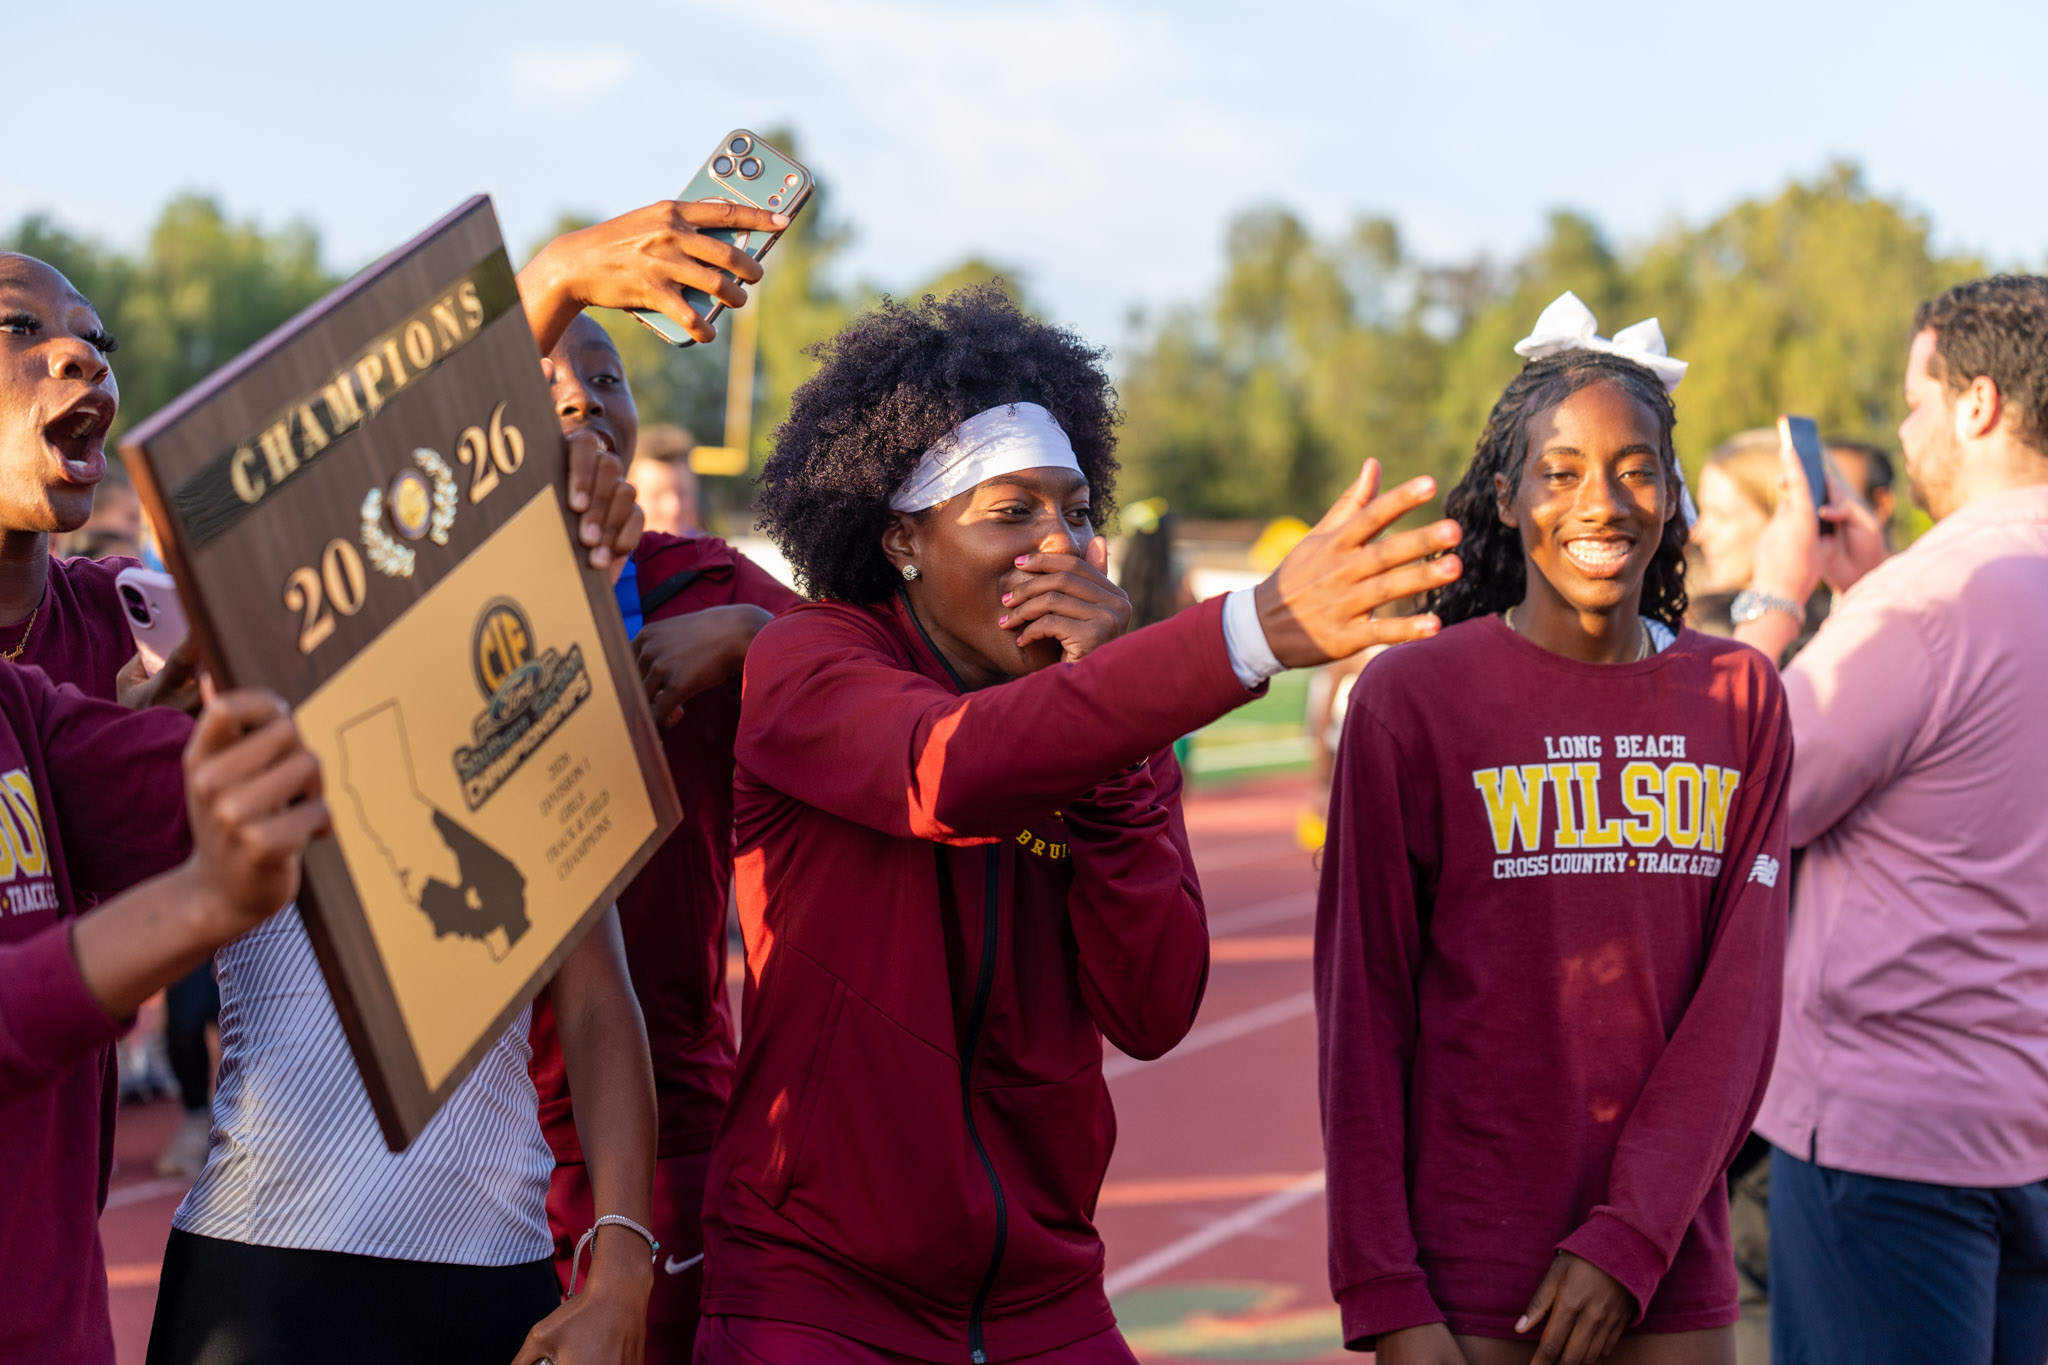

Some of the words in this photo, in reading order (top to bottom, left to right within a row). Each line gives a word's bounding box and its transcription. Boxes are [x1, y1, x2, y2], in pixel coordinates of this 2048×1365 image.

[231, 281, 484, 503] CHAMPIONS
[283, 537, 367, 654] 20
[456, 401, 526, 504] 26
[480, 611, 528, 692] CIF
[1545, 736, 1602, 759] LONG
[1614, 735, 1686, 758] BEACH
[1016, 829, 1070, 859] BRUI
[1472, 761, 1741, 854] WILSON
[1493, 855, 1549, 879] CROSS
[1550, 852, 1629, 874] COUNTRY
[1637, 852, 1690, 874] TRACK
